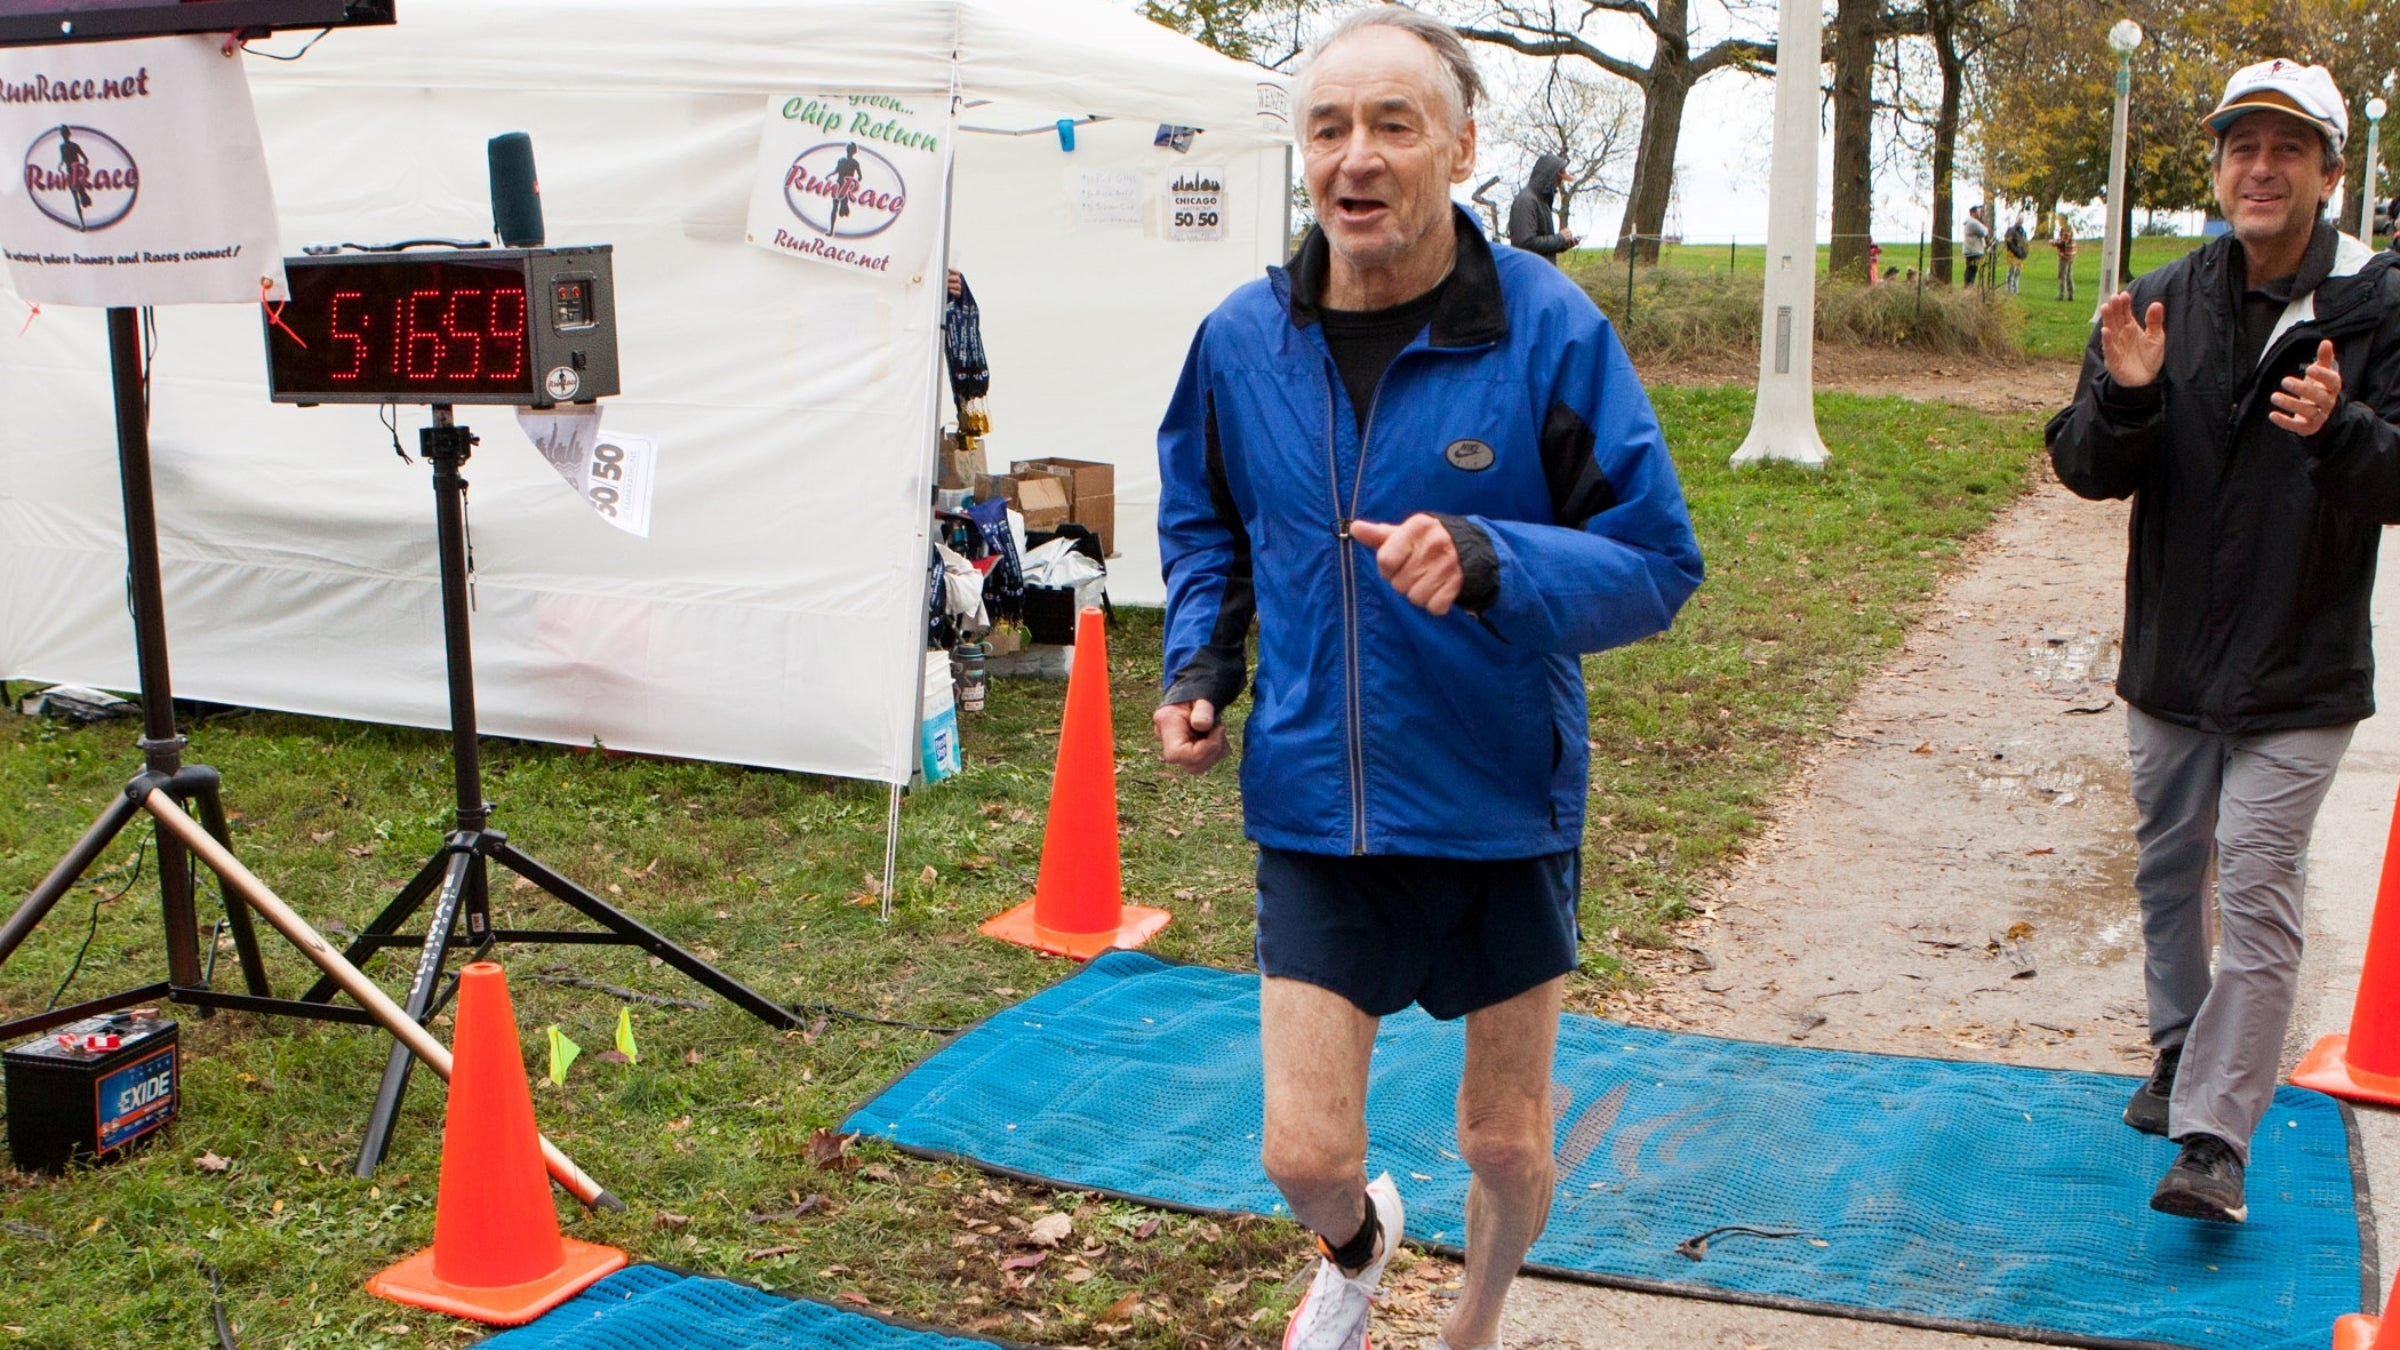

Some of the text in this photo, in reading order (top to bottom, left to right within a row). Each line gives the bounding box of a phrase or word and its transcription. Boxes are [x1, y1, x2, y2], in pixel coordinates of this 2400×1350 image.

[782, 97, 938, 152] Chip Return
[26, 163, 138, 191] RunRace
[784, 165, 905, 214] RunRace
[1175, 197, 1217, 205] CHICAGO
[116, 251, 140, 264] and
[143, 251, 181, 263] Races
[183, 244, 241, 261] connect!
[774, 228, 889, 272] RunRace.net
[330, 287, 525, 379] 5:16:59
[409, 873, 456, 995] ULTIMATE
[118, 1070, 171, 1114] EXIDE
